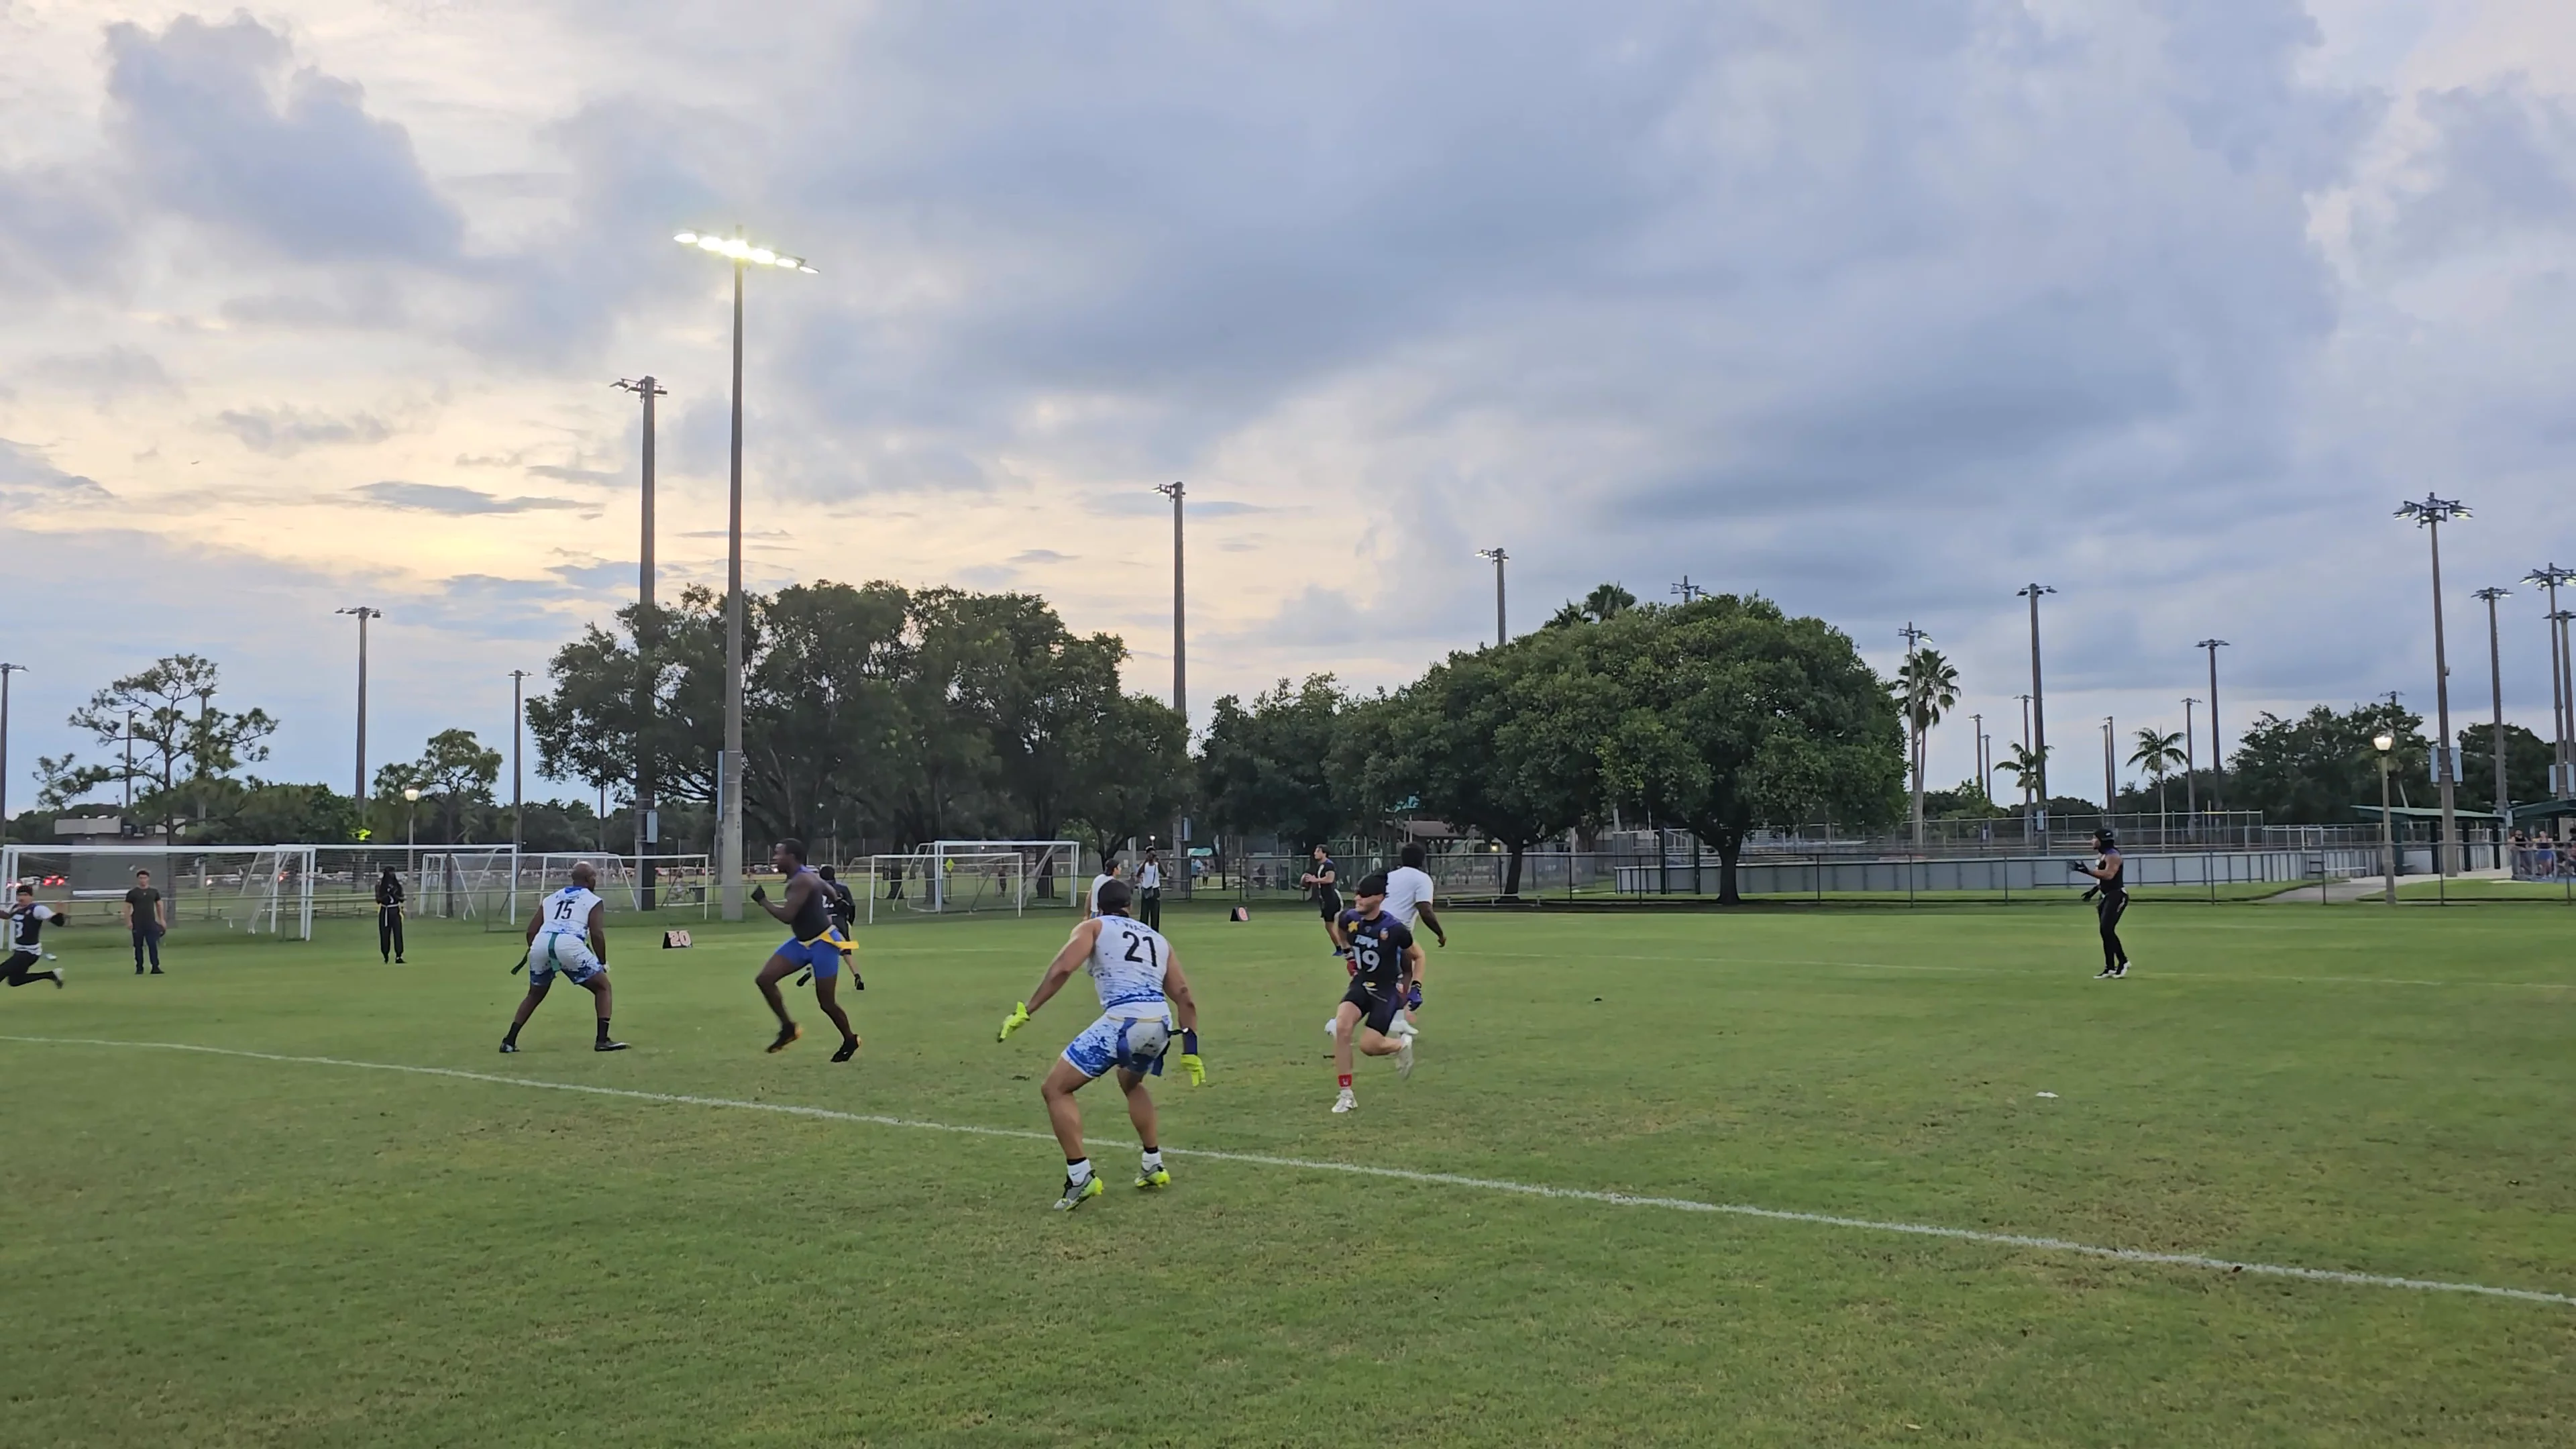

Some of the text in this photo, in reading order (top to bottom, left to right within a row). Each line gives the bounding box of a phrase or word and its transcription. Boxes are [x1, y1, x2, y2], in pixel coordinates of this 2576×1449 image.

[554, 900, 575, 920] 15
[667, 930, 692, 947] 20
[1122, 930, 1157, 967] 21
[1352, 946, 1380, 973] 19
